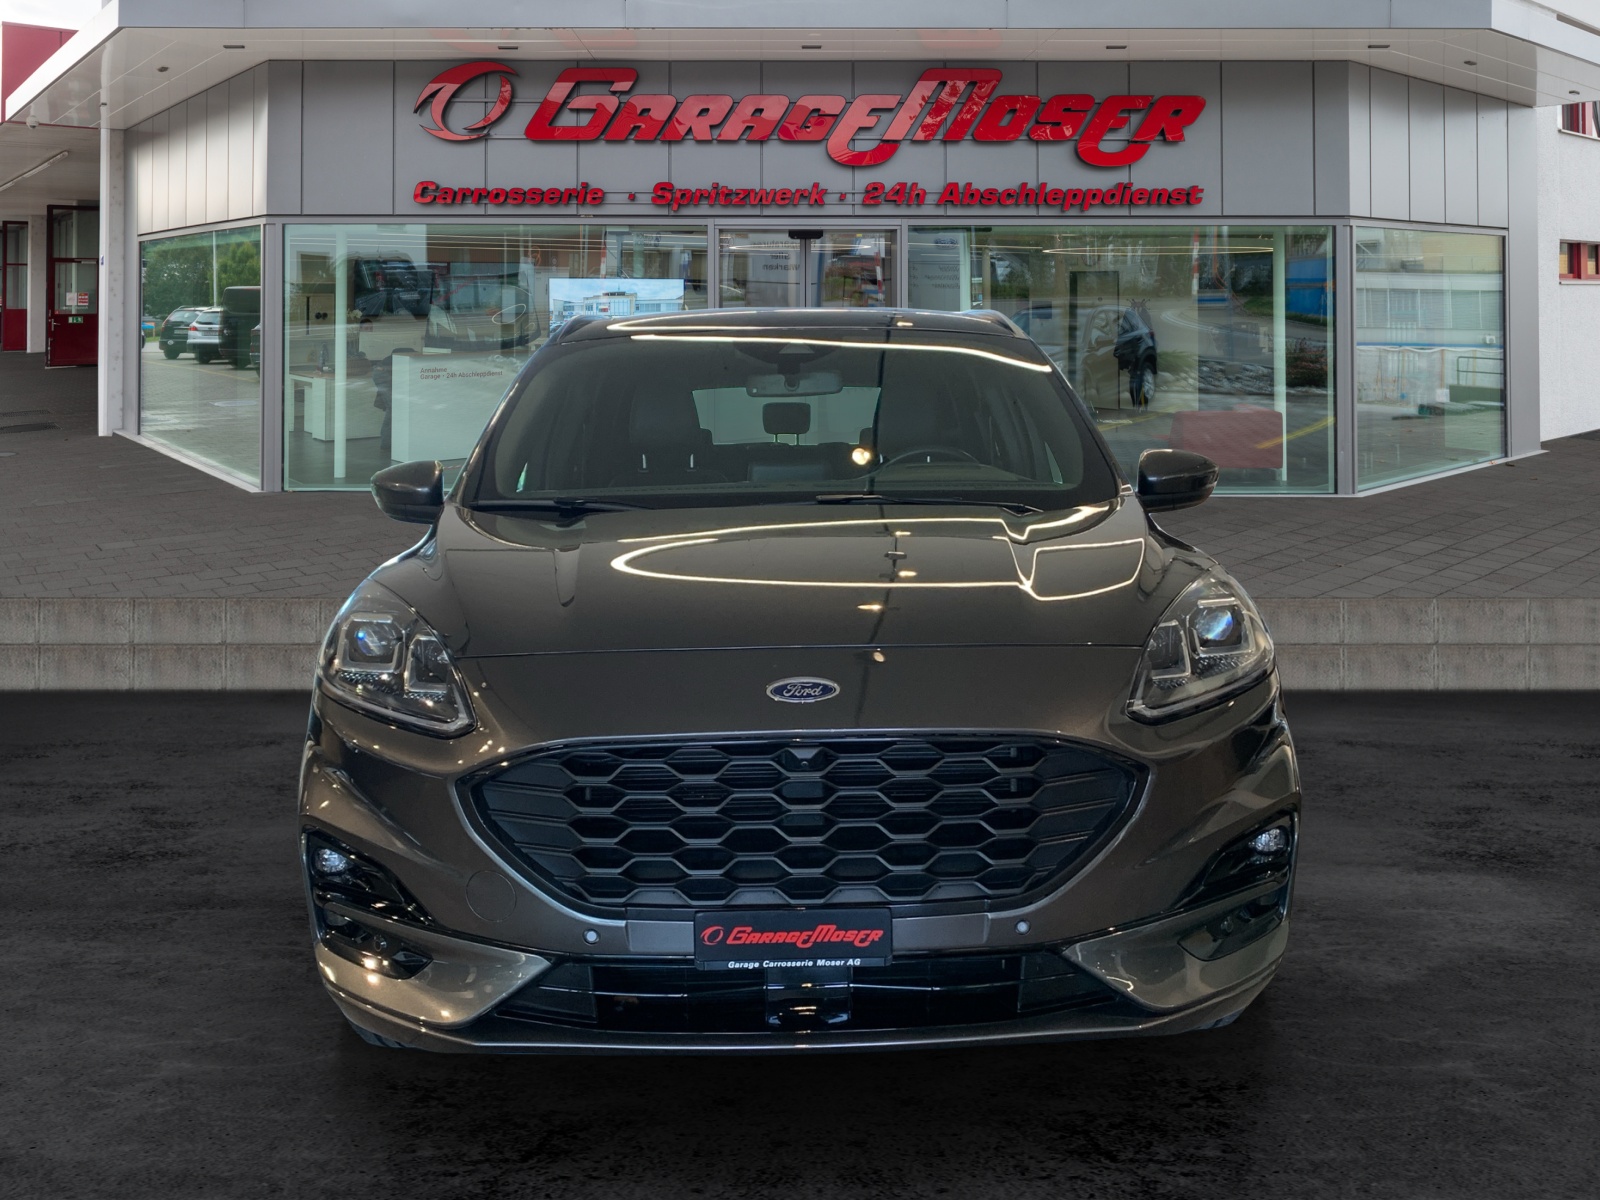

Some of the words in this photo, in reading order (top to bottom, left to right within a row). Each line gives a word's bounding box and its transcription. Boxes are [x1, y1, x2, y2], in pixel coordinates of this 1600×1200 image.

[413, 181, 605, 206] Carrosserie
[650, 182, 827, 211] Spritzwerk
[862, 182, 927, 206] 24h
[937, 182, 1205, 212] Abschleppdienst
[458, 370, 503, 378] Abschleppdienst
[783, 683, 822, 697] Ford
[728, 961, 760, 970] Garage
[763, 960, 814, 968] Carrosserie
[816, 959, 845, 967] Moser
[847, 958, 862, 966] AG
